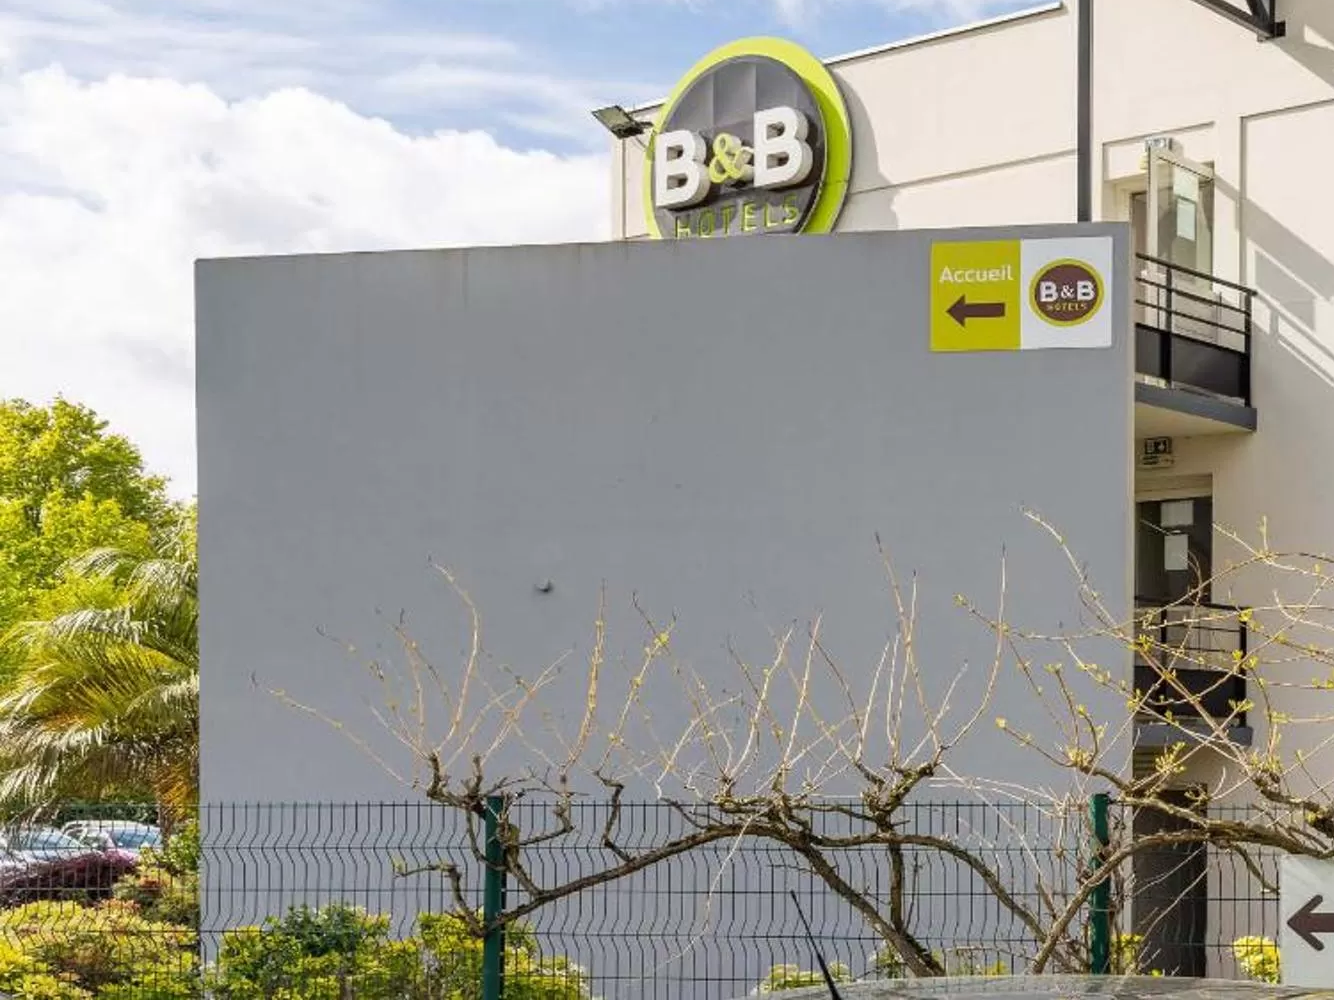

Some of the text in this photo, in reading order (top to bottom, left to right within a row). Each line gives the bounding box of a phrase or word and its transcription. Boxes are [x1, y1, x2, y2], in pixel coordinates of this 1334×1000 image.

[655, 105, 813, 209] B&B
[674, 196, 800, 239] HOTELS
[939, 264, 1014, 284] Accueil
[1039, 280, 1096, 302] B&B
[1046, 302, 1087, 312] HOTELS
